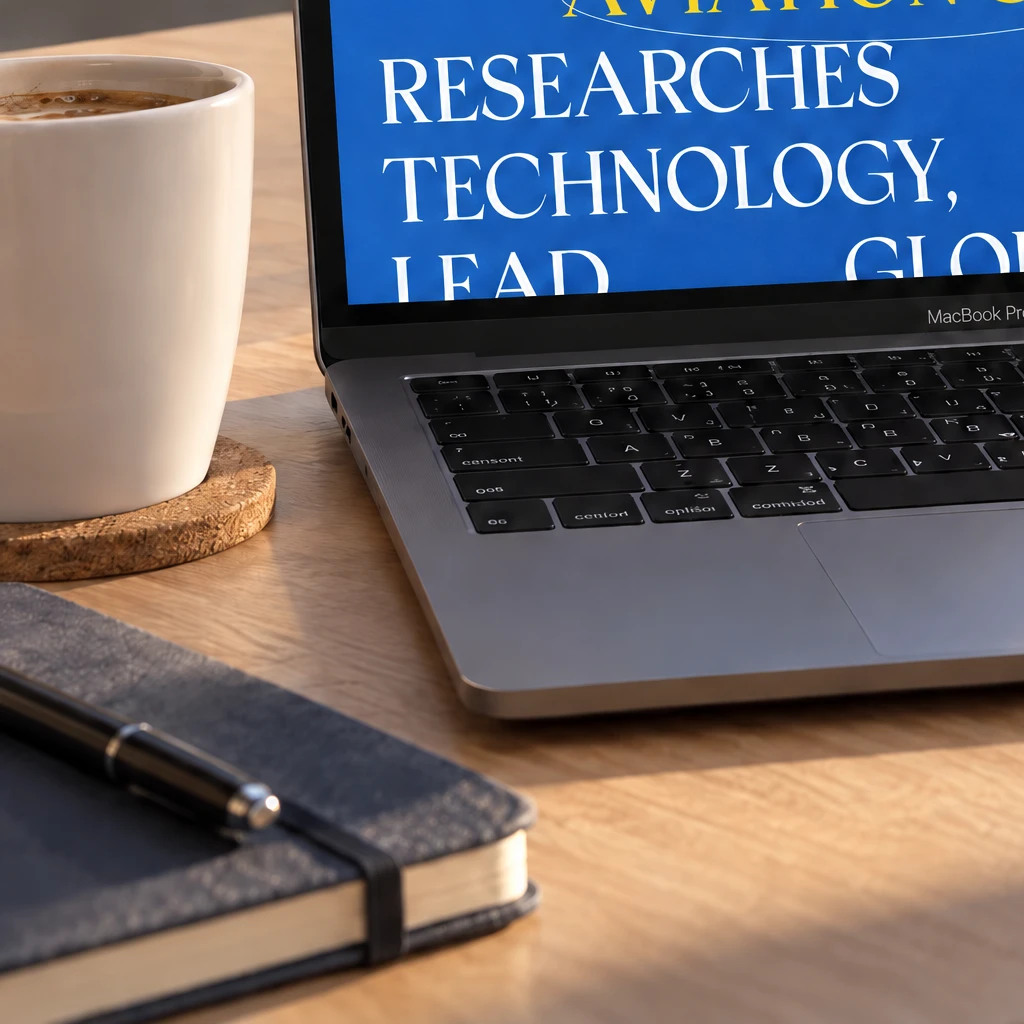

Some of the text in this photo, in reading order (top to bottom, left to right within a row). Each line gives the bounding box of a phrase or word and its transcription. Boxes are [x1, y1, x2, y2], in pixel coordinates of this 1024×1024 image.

[379, 42, 900, 125] RESEARCHES
[382, 137, 958, 223] TECHNOLOGY,
[927, 305, 1002, 325] MacBook
